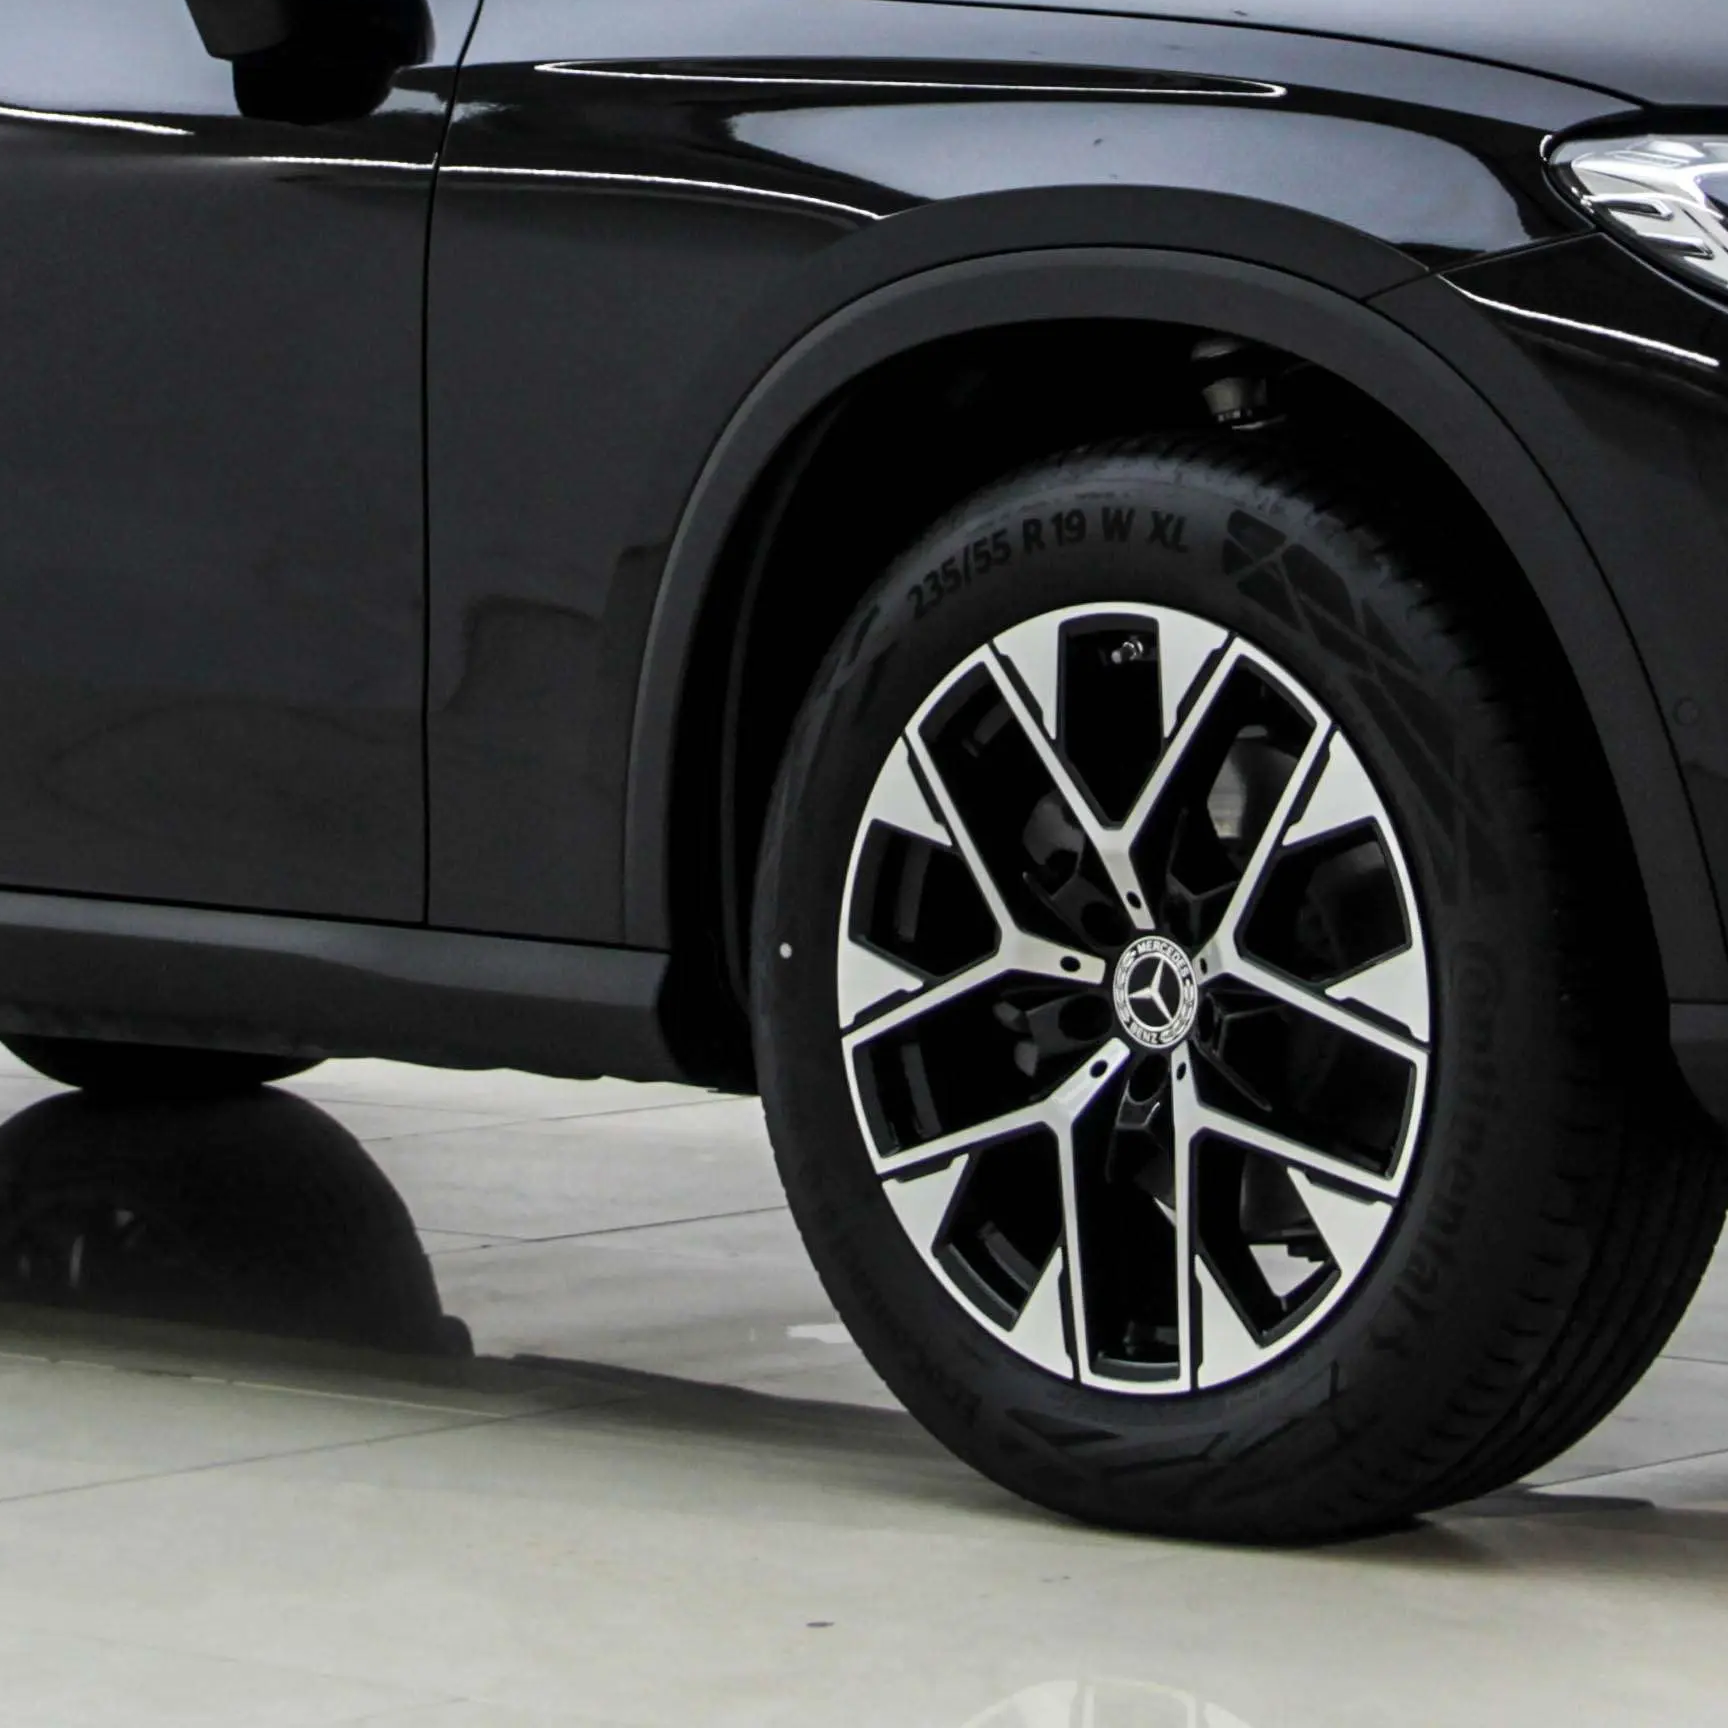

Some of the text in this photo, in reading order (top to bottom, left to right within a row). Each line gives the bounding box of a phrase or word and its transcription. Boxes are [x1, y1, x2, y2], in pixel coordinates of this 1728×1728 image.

[908, 529, 1012, 617] 235/55
[1102, 506, 1136, 543] W
[1146, 511, 1190, 553] XL
[1137, 940, 1189, 977] MERCEDES
[1130, 1023, 1158, 1044] BENZ
